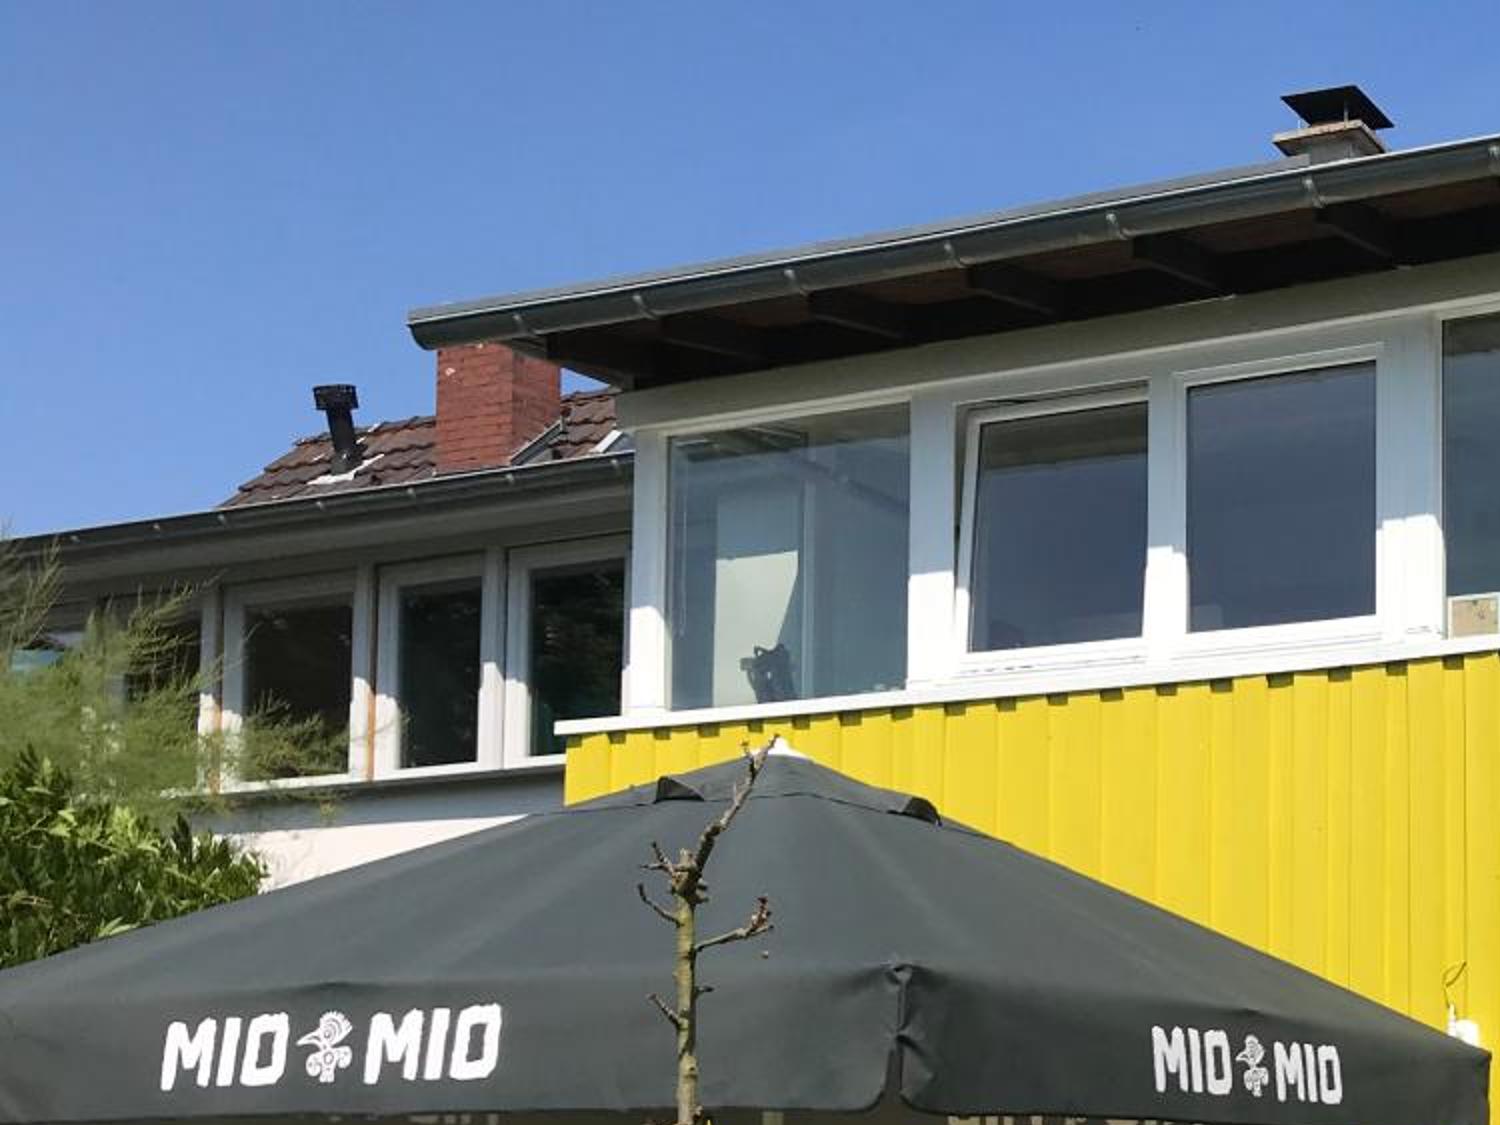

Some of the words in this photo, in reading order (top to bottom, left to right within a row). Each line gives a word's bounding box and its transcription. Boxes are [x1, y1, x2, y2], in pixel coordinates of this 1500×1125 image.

[160, 1011, 290, 1092] MIO
[363, 1002, 503, 1085] MIO
[1151, 1025, 1233, 1095] MIO
[1273, 1041, 1343, 1105] MIO
